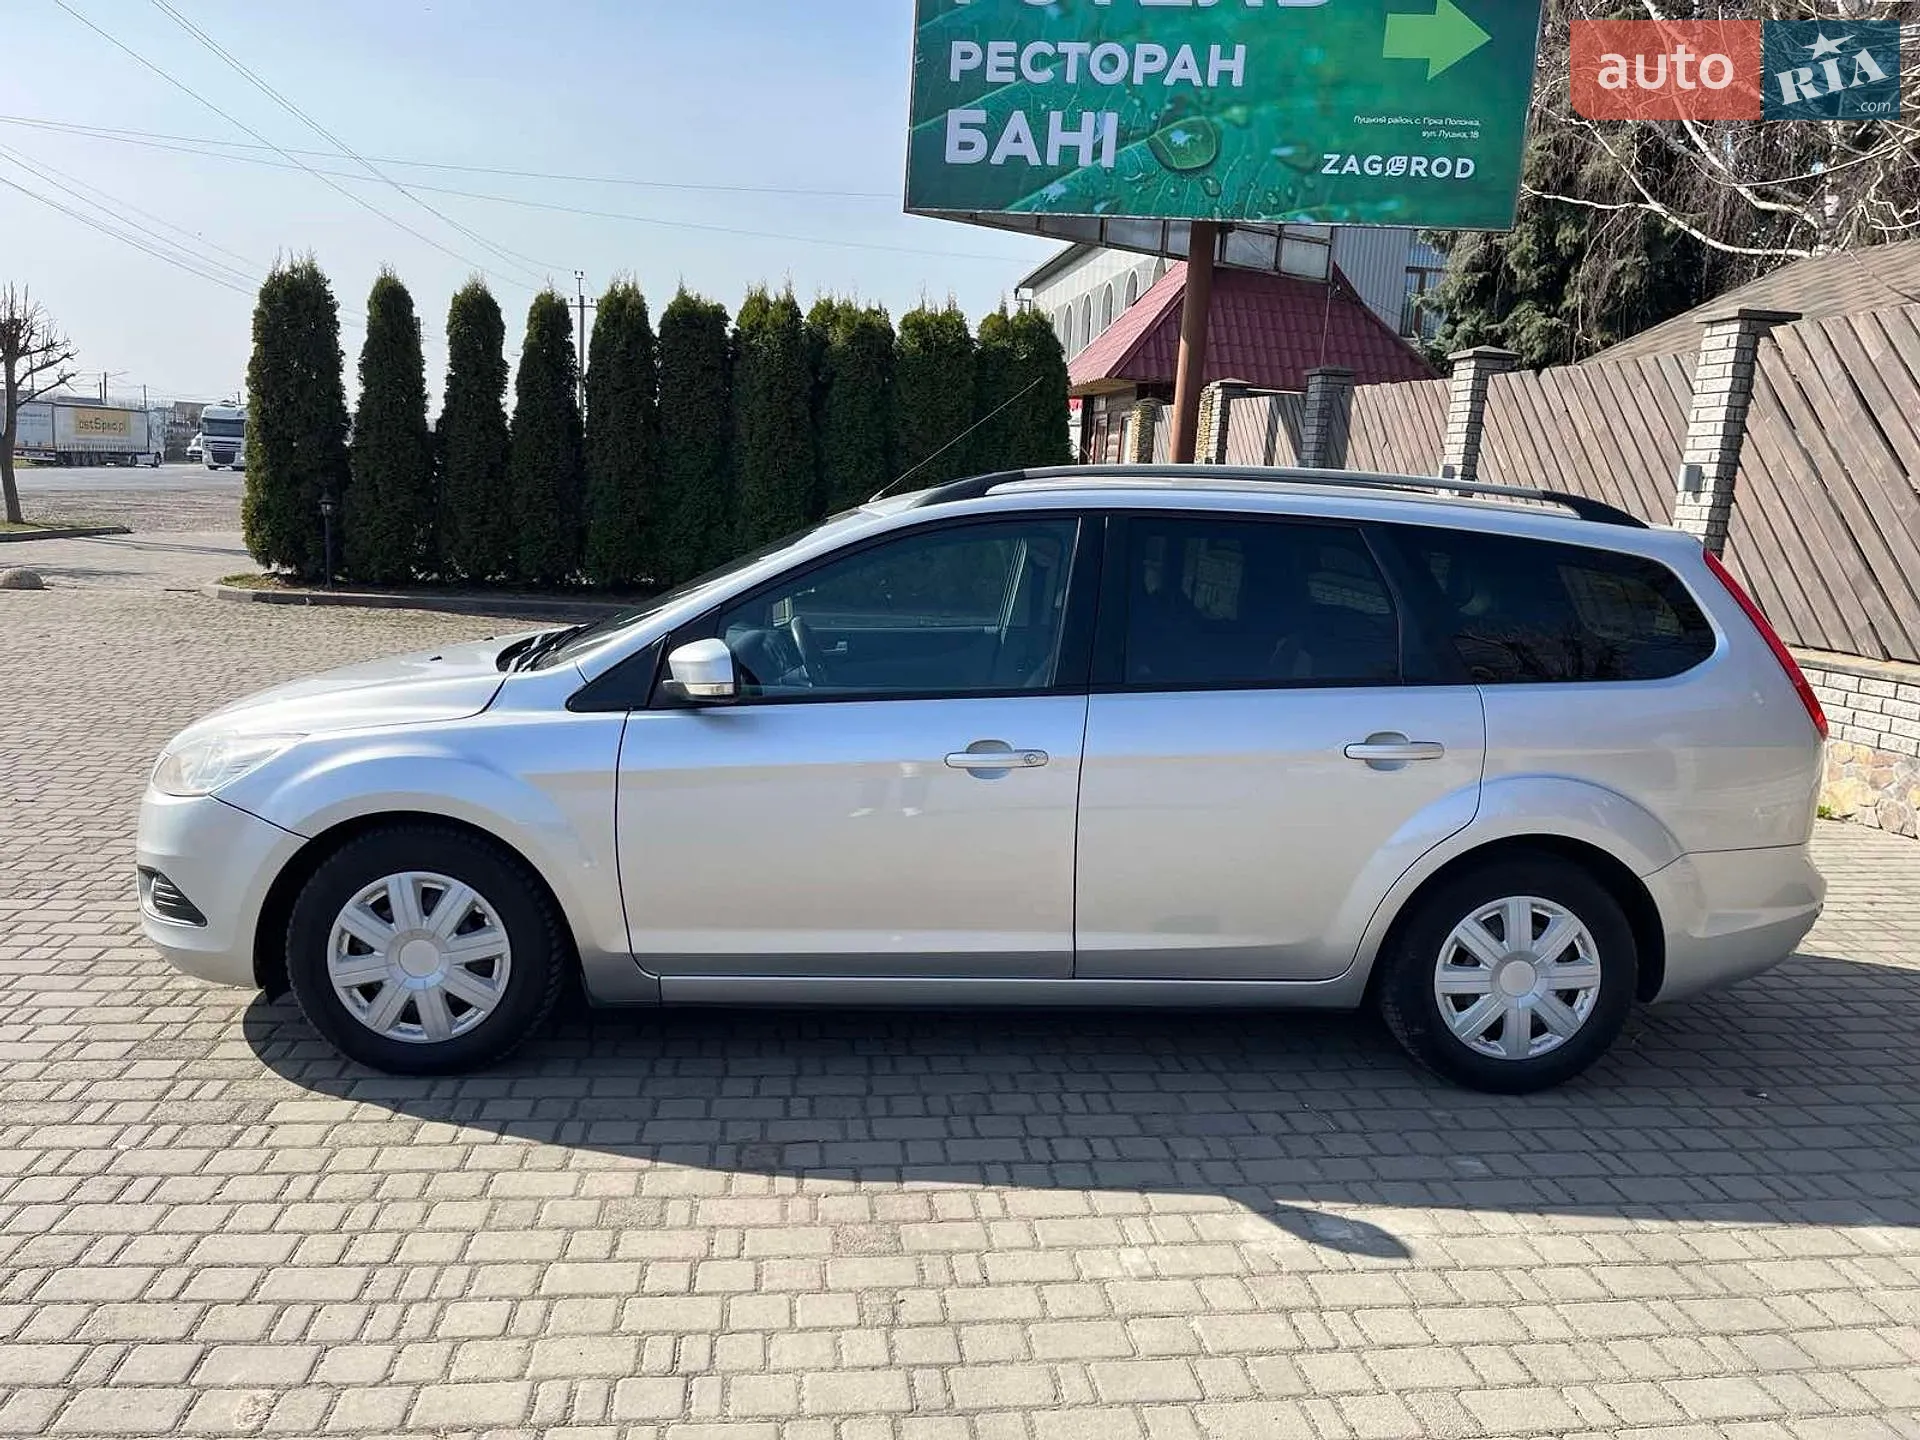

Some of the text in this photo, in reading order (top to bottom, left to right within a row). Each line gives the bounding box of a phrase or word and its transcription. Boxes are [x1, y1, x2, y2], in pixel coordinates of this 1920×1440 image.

[950, 40, 1246, 87] РЕСТОРАН
[945, 109, 1119, 168] БАНІ
[1321, 153, 1475, 179] ZAGOROD
